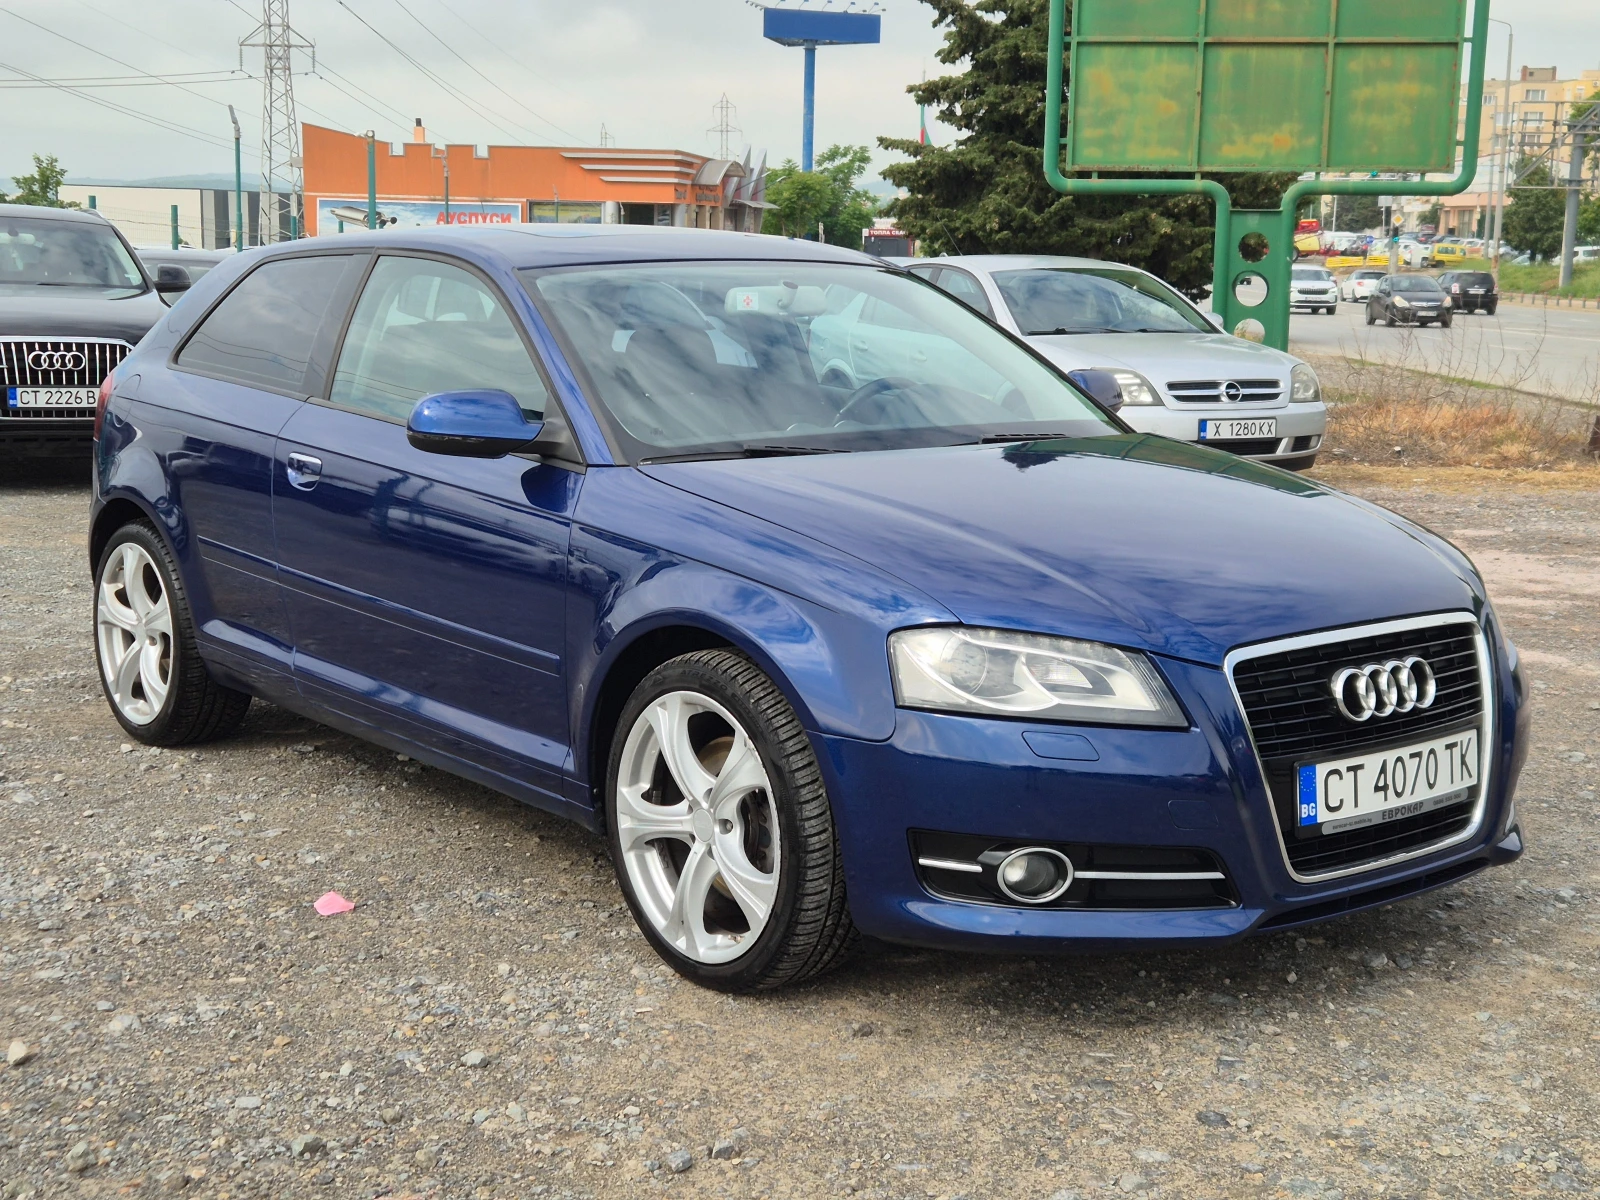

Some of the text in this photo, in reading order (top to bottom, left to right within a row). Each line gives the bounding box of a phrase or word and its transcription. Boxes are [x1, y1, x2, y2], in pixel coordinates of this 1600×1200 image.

[436, 211, 512, 225] АУСПУСИ
[20, 390, 97, 405] CT 2226 B
[1229, 422, 1257, 437] 1280
[1323, 736, 1473, 813] CT 4070 TK
[1301, 802, 1316, 818] BG
[1382, 801, 1424, 821] ЕВРОКАР
